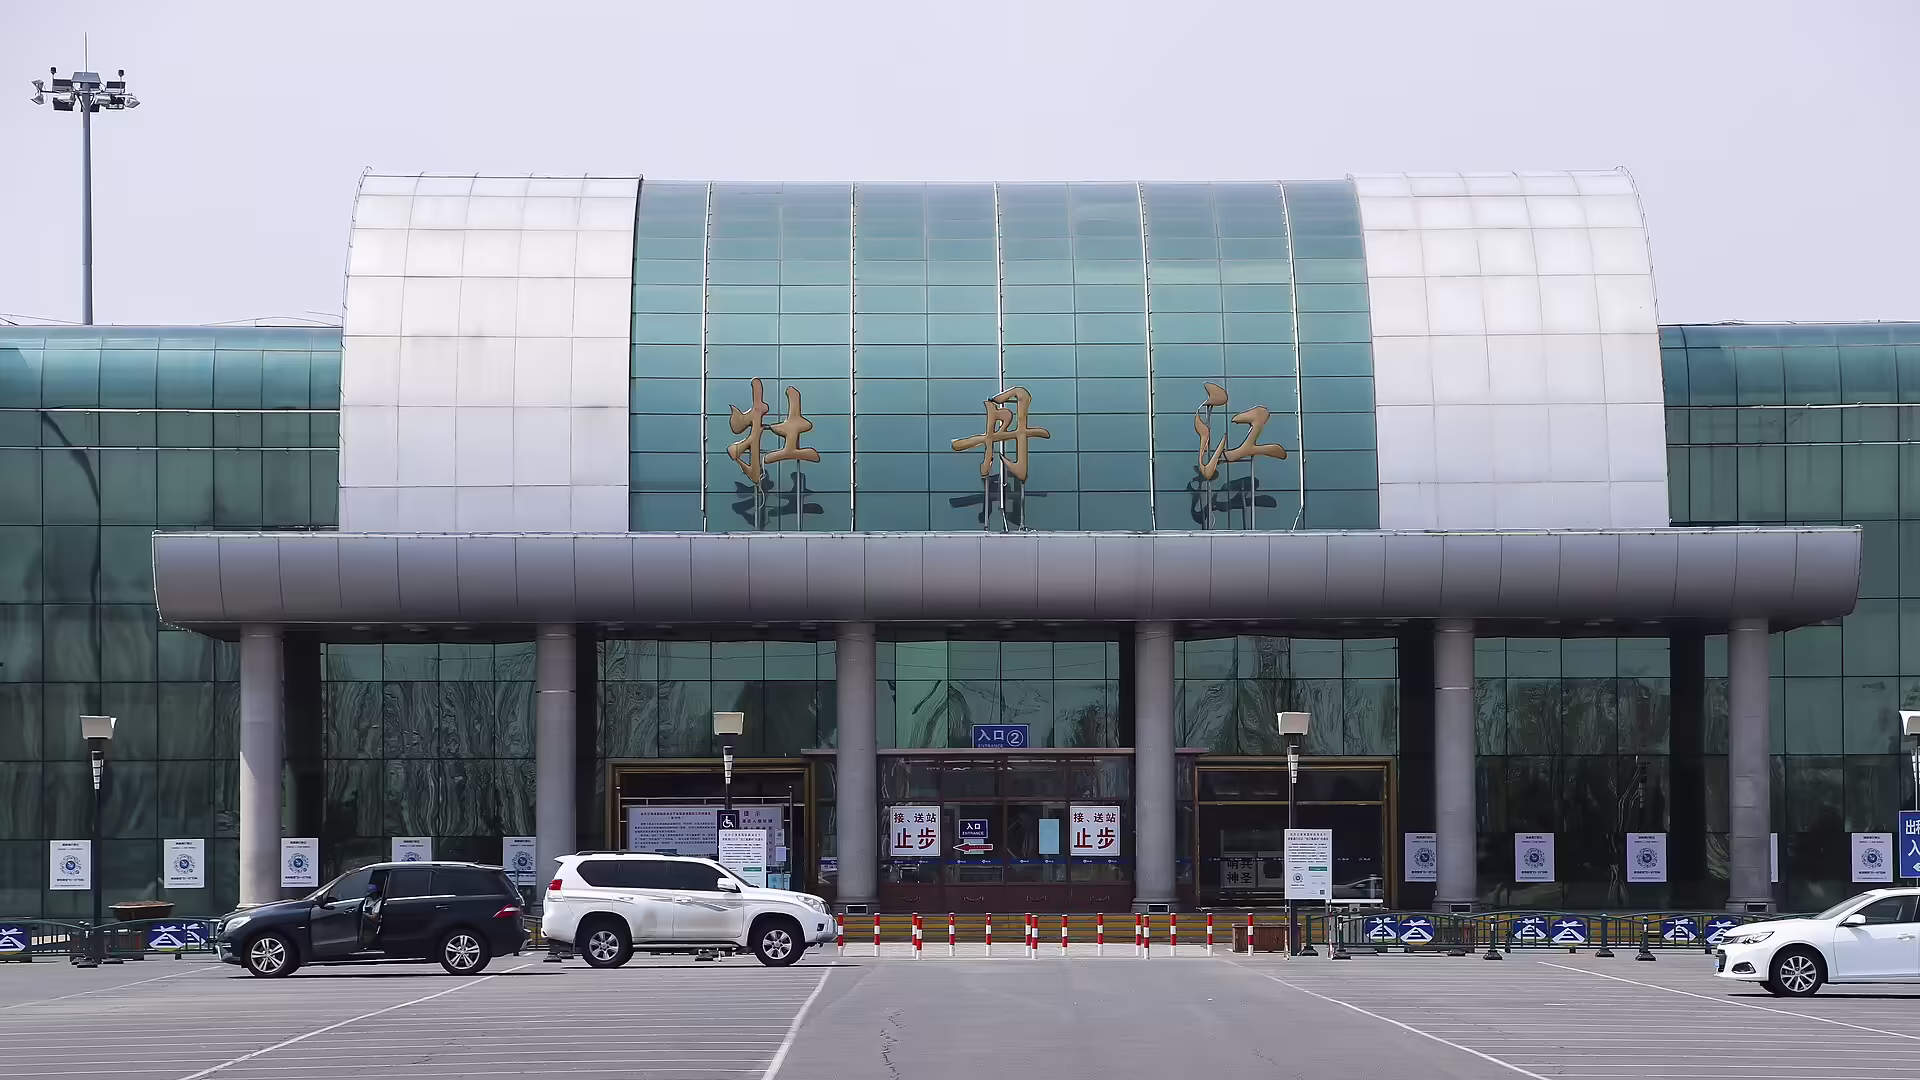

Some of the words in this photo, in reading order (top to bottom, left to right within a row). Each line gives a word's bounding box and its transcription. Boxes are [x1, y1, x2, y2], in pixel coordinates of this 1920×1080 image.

[726, 377, 1288, 483] 牡丹江
[894, 812, 937, 823] 接、送站
[1073, 812, 1116, 823] 接、送站
[966, 822, 981, 830] 入口
[894, 827, 937, 849] 止步
[1073, 826, 1116, 849] 止步
[1227, 871, 1253, 884] 神圣
